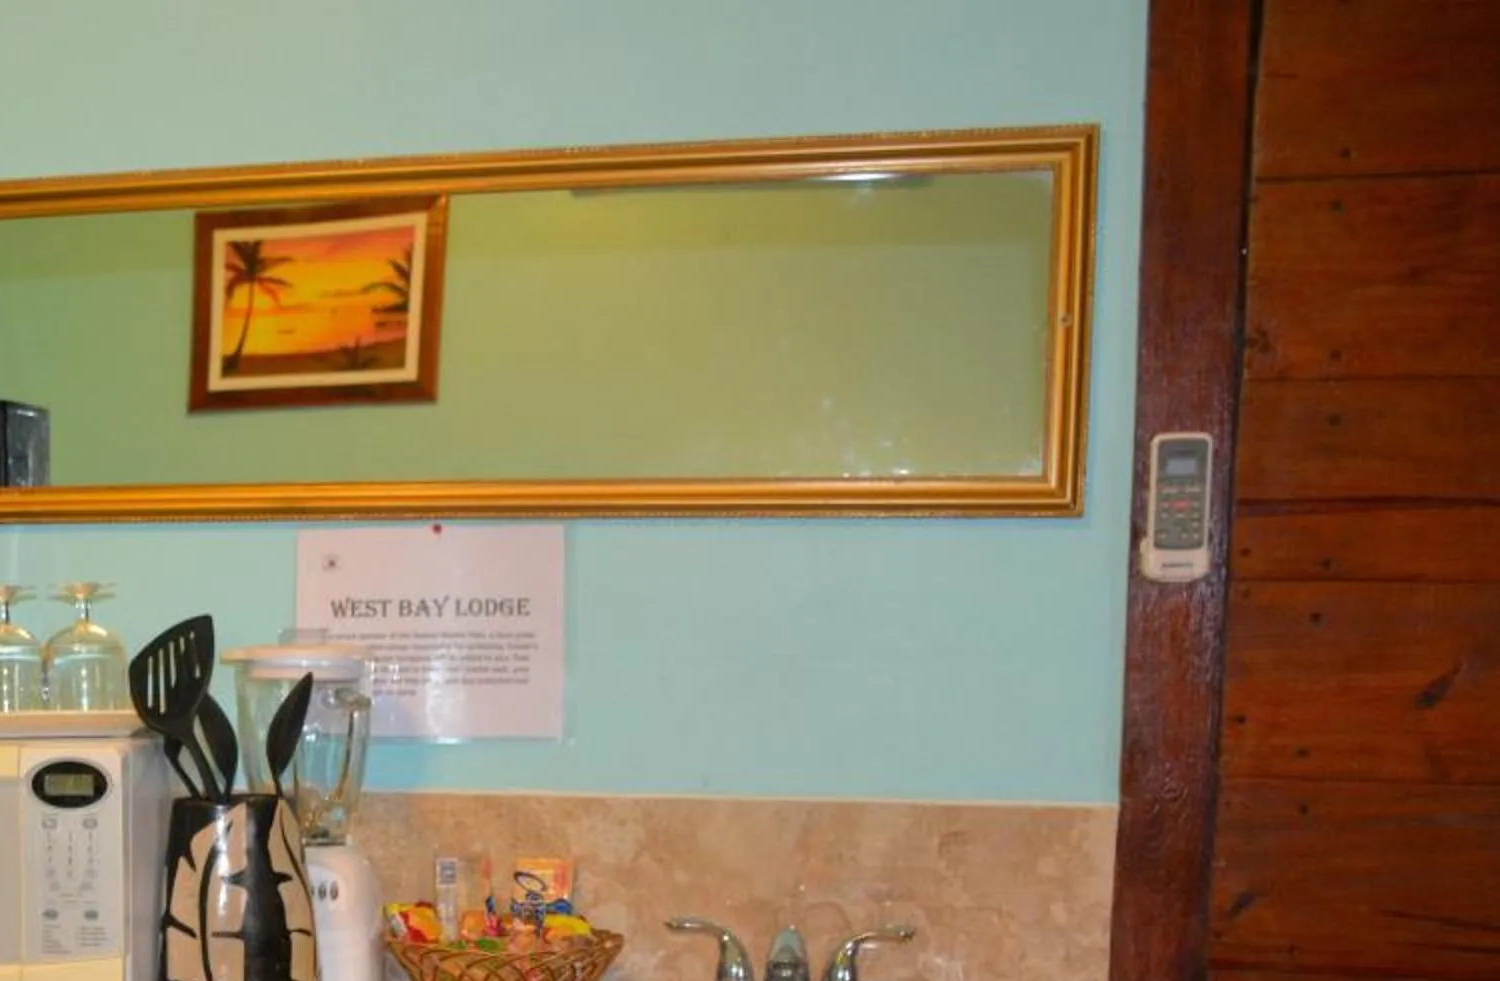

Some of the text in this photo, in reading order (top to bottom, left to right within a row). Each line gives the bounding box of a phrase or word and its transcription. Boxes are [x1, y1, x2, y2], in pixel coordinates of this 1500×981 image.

[330, 595, 532, 619] WEST BAY LODGE
